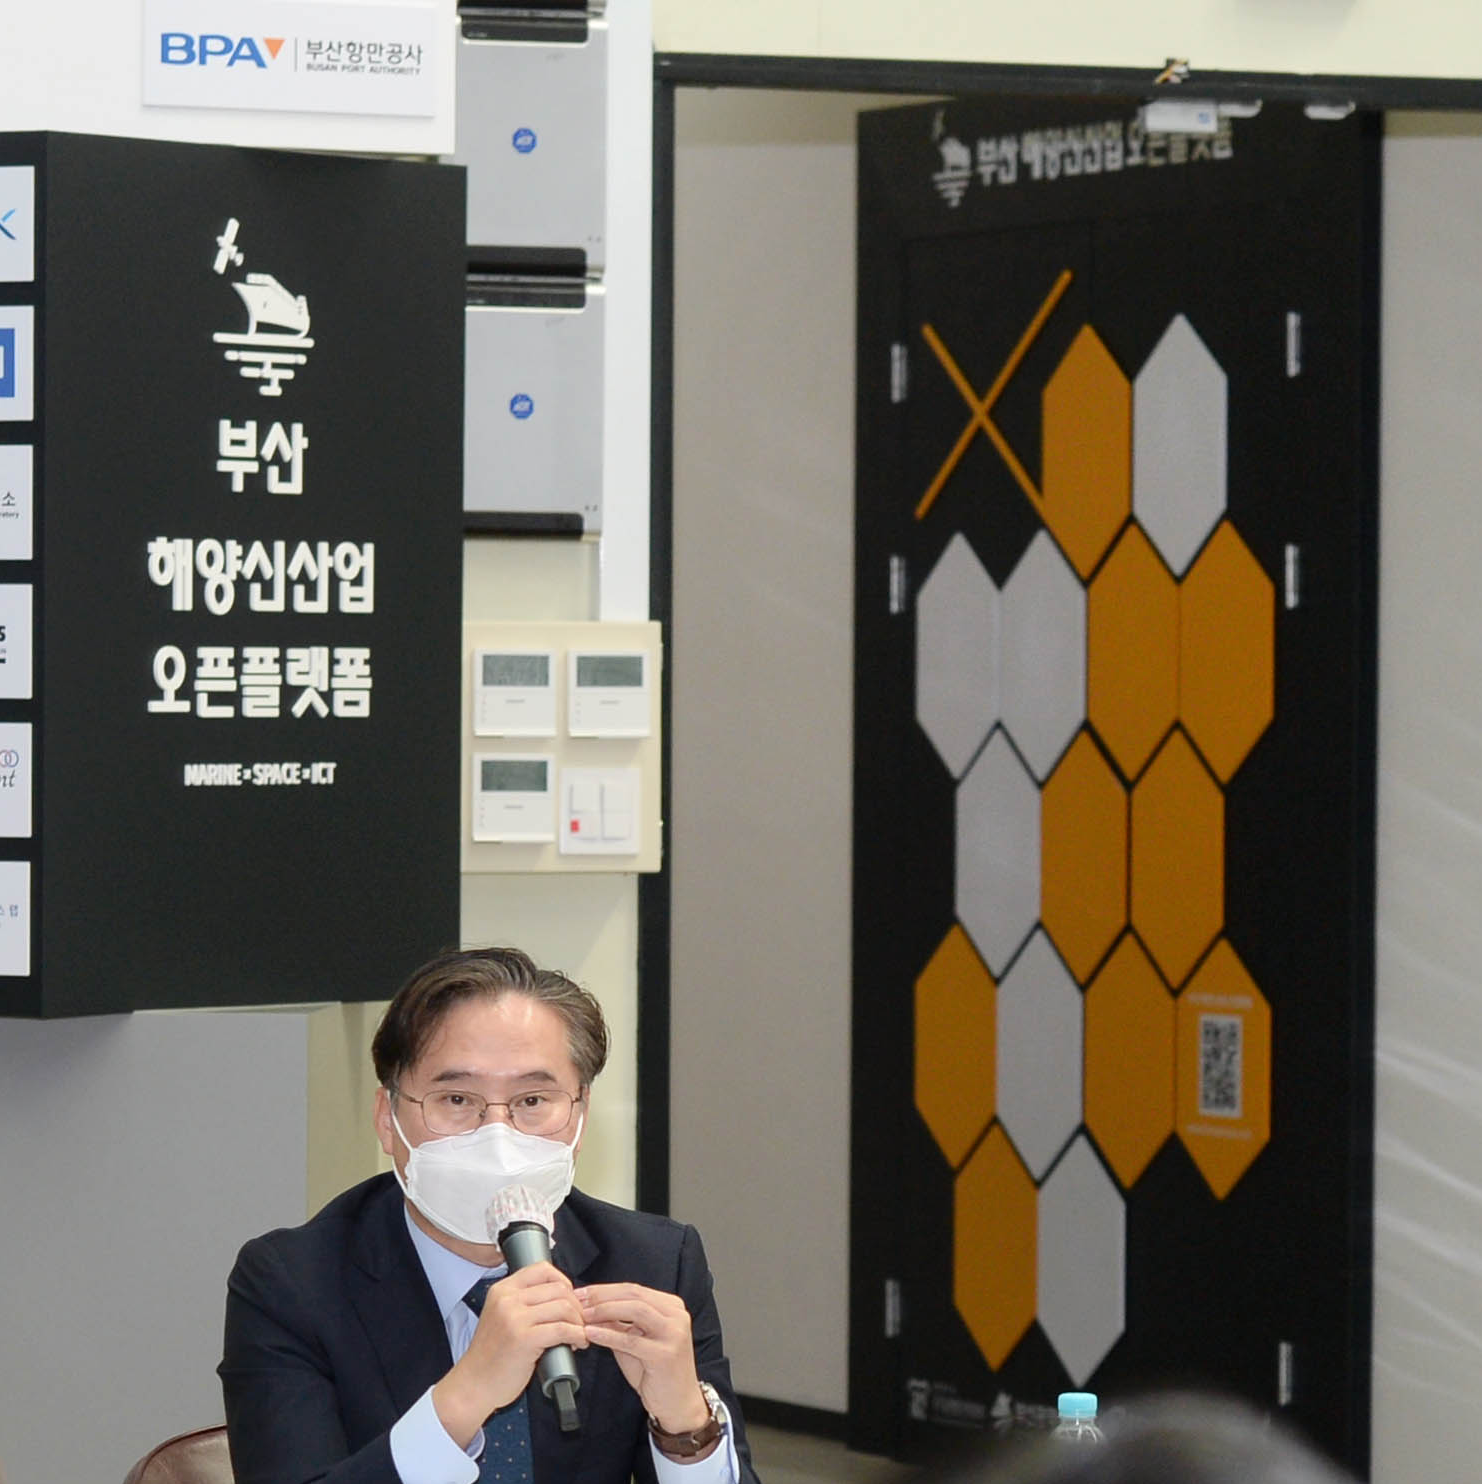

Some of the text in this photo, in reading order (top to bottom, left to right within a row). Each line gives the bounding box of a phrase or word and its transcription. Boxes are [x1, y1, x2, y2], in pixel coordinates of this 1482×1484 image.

[160, 32, 268, 69] BPA
[306, 39, 424, 66] 부산항만공사
[306, 63, 421, 76] BUSAN PORT AUTHORITY
[216, 418, 309, 495] 부산
[146, 536, 376, 616] 해양신산업
[146, 645, 374, 719] 오픈플랫폼
